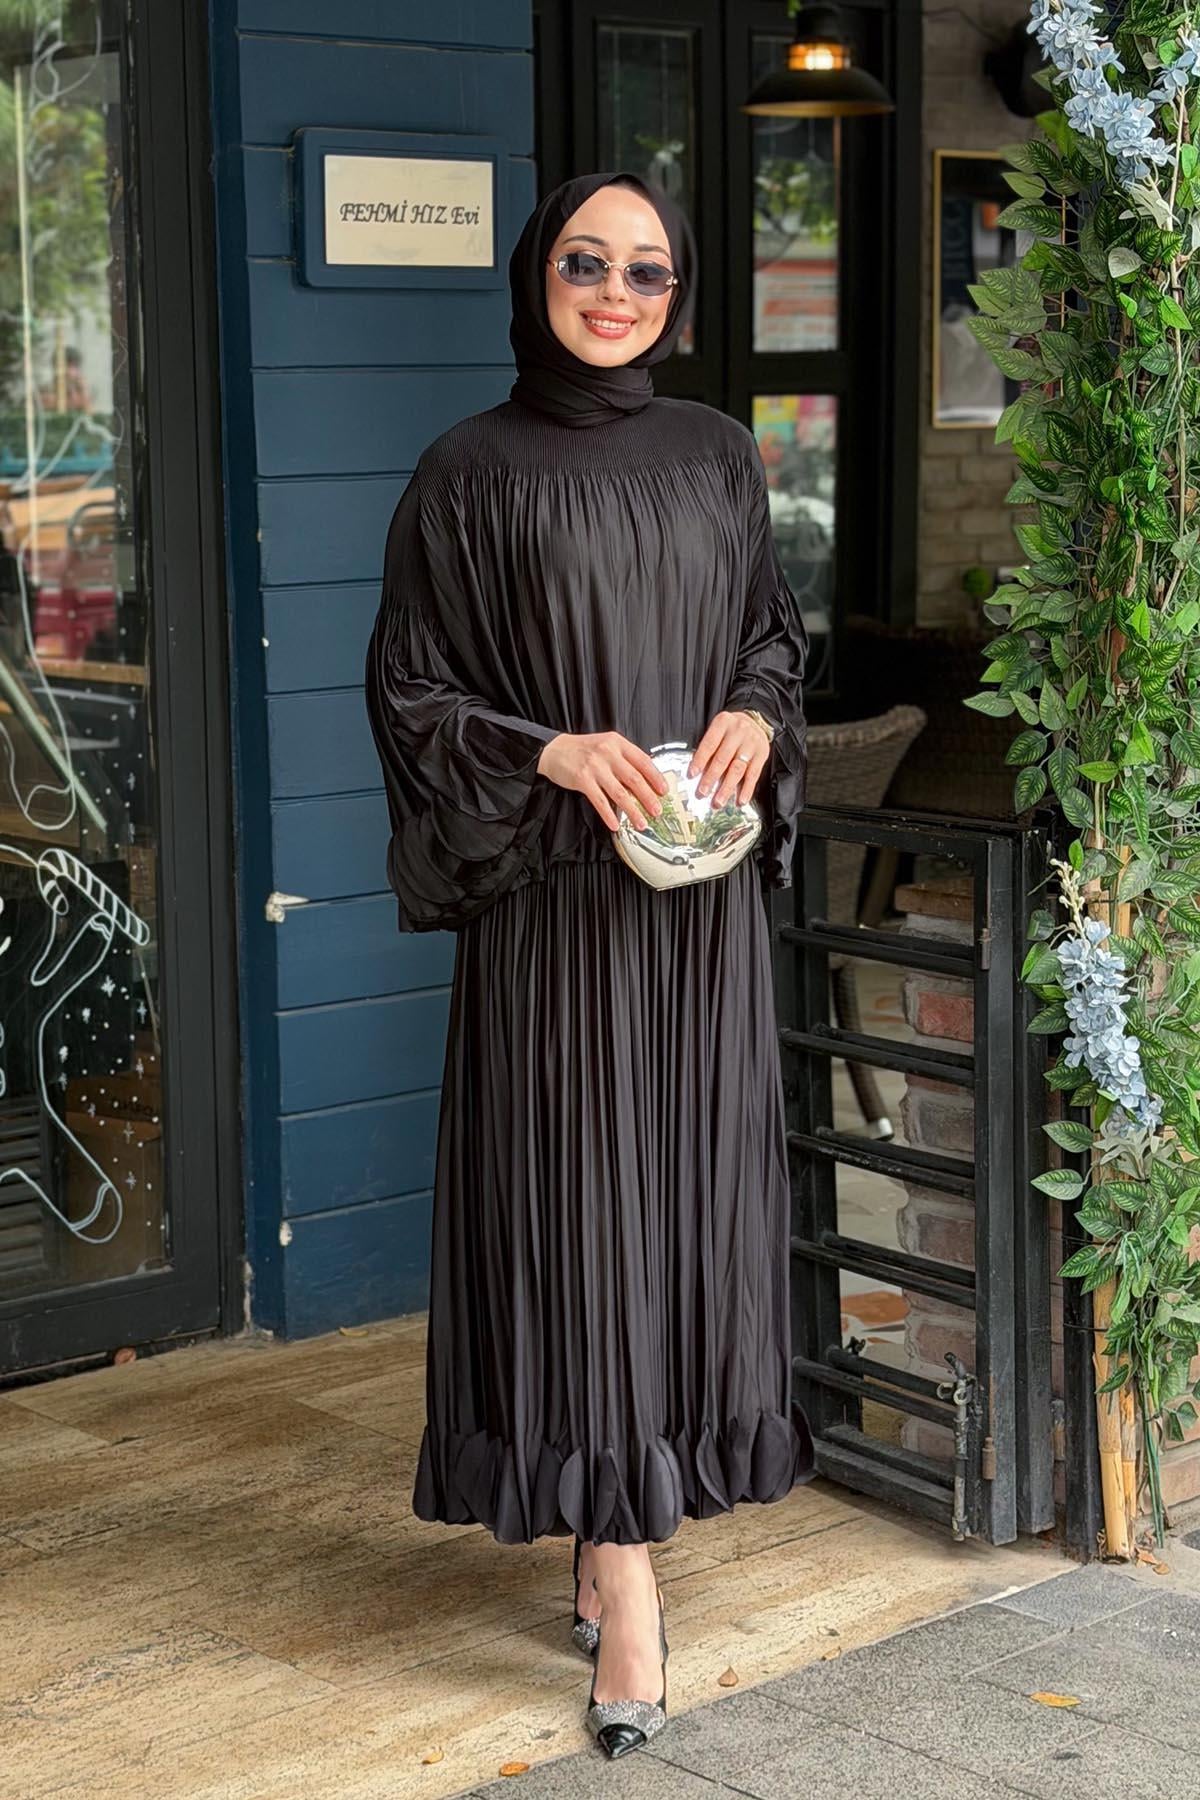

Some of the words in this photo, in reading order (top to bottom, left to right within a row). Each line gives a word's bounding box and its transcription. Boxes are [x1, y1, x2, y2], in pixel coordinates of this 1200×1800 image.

[340, 200, 407, 223] FEHMİ
[410, 204, 448, 224] HIZ
[451, 206, 480, 225] Evi
